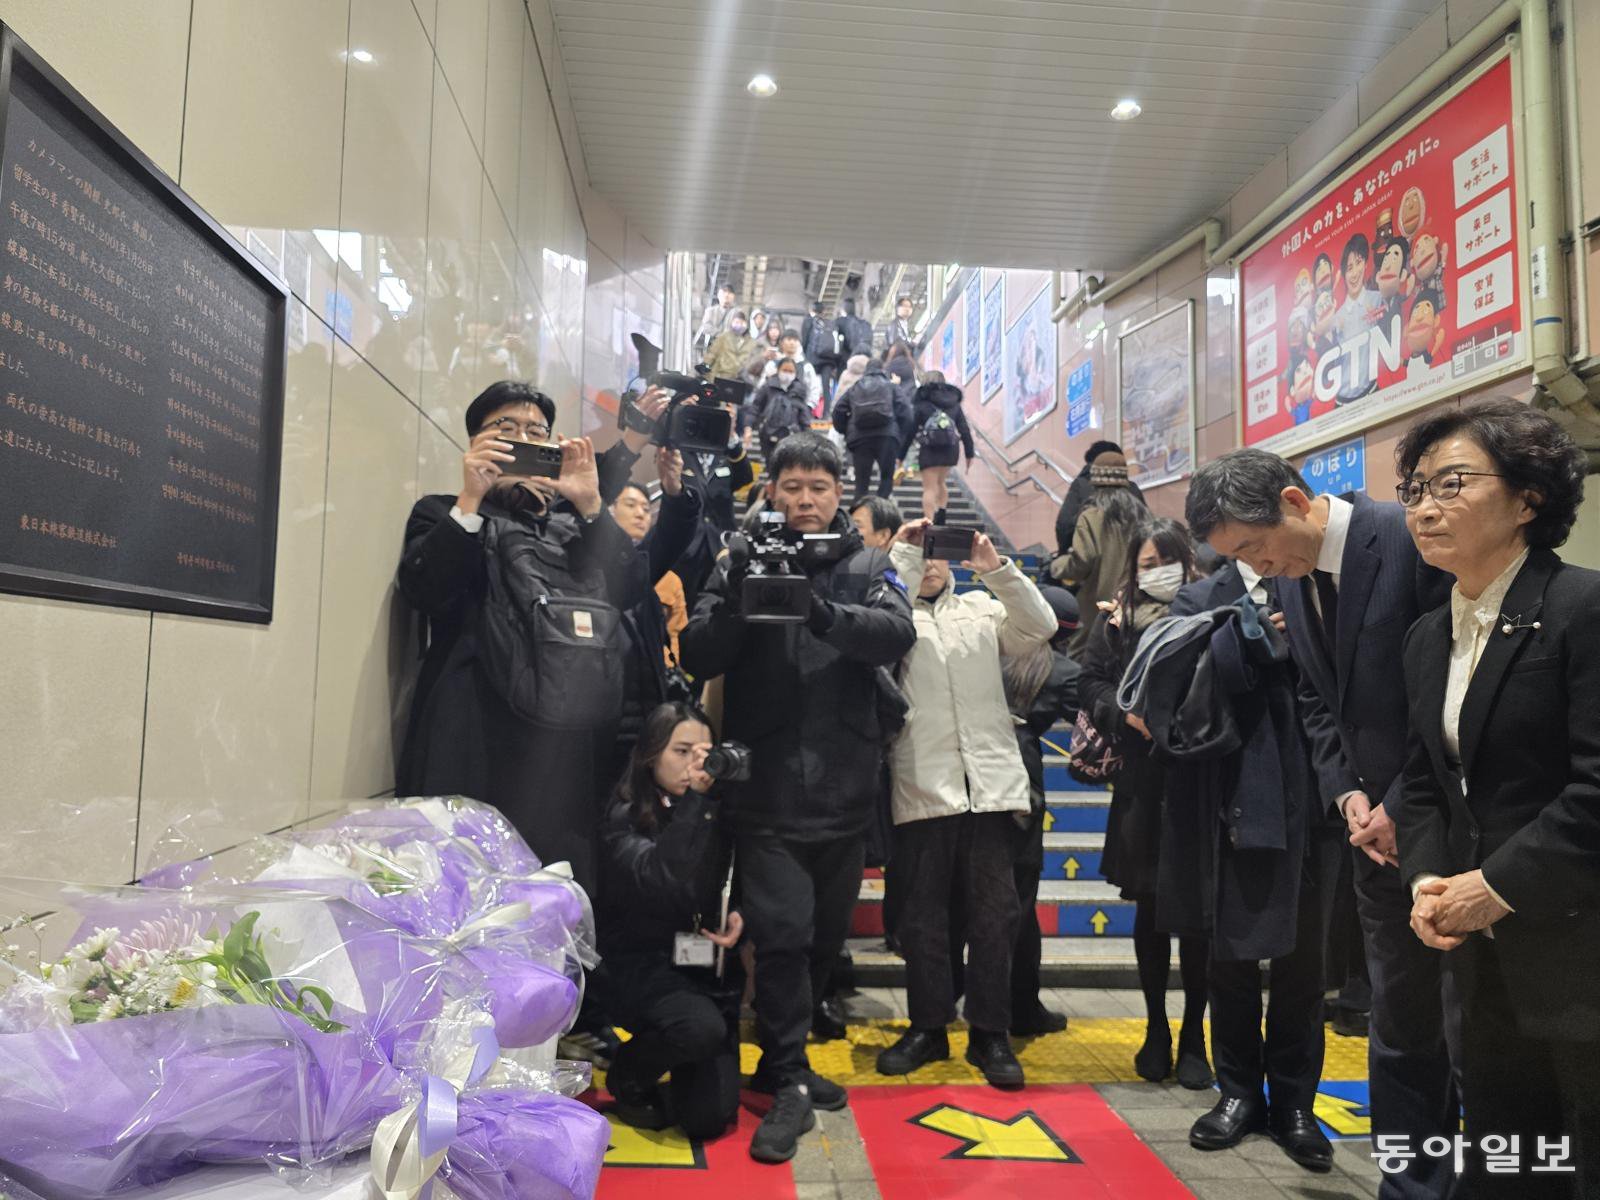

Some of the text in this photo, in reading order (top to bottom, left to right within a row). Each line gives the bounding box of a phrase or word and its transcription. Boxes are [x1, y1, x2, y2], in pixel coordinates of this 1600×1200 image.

[1470, 148, 1490, 171] 生活
[1463, 162, 1499, 191] サポート
[1281, 138, 1440, 258] 外国人の力を、あなたの力に。
[1465, 225, 1501, 253] サポート
[1473, 272, 1494, 293] 家賃
[1474, 291, 1495, 311] 保証
[1314, 314, 1401, 402] GTN
[1311, 447, 1357, 477] のぼり
